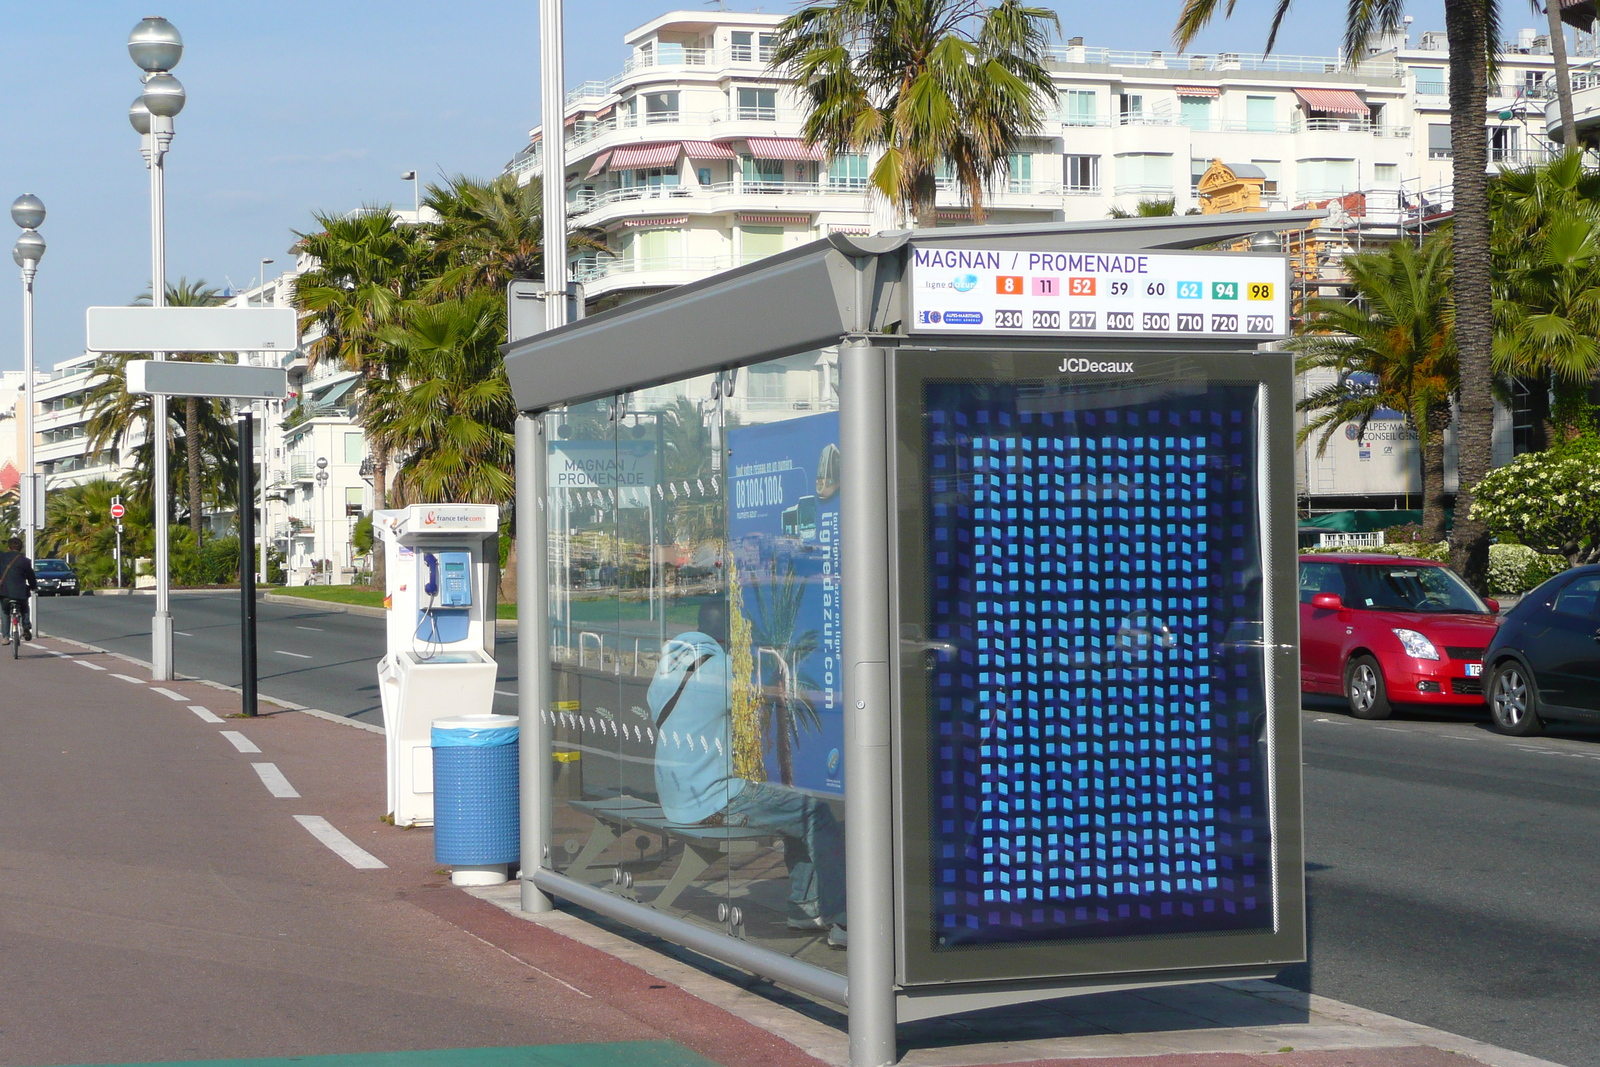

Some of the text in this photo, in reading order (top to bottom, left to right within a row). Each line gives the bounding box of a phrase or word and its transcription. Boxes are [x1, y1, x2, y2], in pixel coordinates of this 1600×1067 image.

[915, 250, 1148, 273] MAGNAN / PROMENADE
[926, 281, 946, 289] ligne
[1004, 277, 1015, 292] 8
[1040, 280, 1052, 293] 11
[1072, 279, 1092, 293] 52
[1110, 282, 1129, 296] 59
[1146, 282, 1166, 296] 60
[1180, 283, 1199, 298] 62
[1215, 284, 1235, 298] 94
[1251, 285, 1270, 299] 98
[995, 311, 1023, 328] 230
[1033, 312, 1060, 328] 200
[1071, 313, 1096, 328] 217
[1106, 314, 1134, 330] 400
[1143, 315, 1170, 330] 500
[1179, 315, 1203, 331] 710
[1212, 316, 1238, 331] 720
[1247, 317, 1273, 332] 790
[1058, 358, 1134, 373] JCDecaux
[1363, 432, 1396, 441] CONSEIL
[565, 459, 624, 471] MAGNAN
[558, 472, 644, 485] PROMENADE
[832, 538, 840, 568] ligne
[819, 512, 834, 709] lignedazur.com
[834, 613, 840, 627] en
[834, 631, 842, 661] ligne
